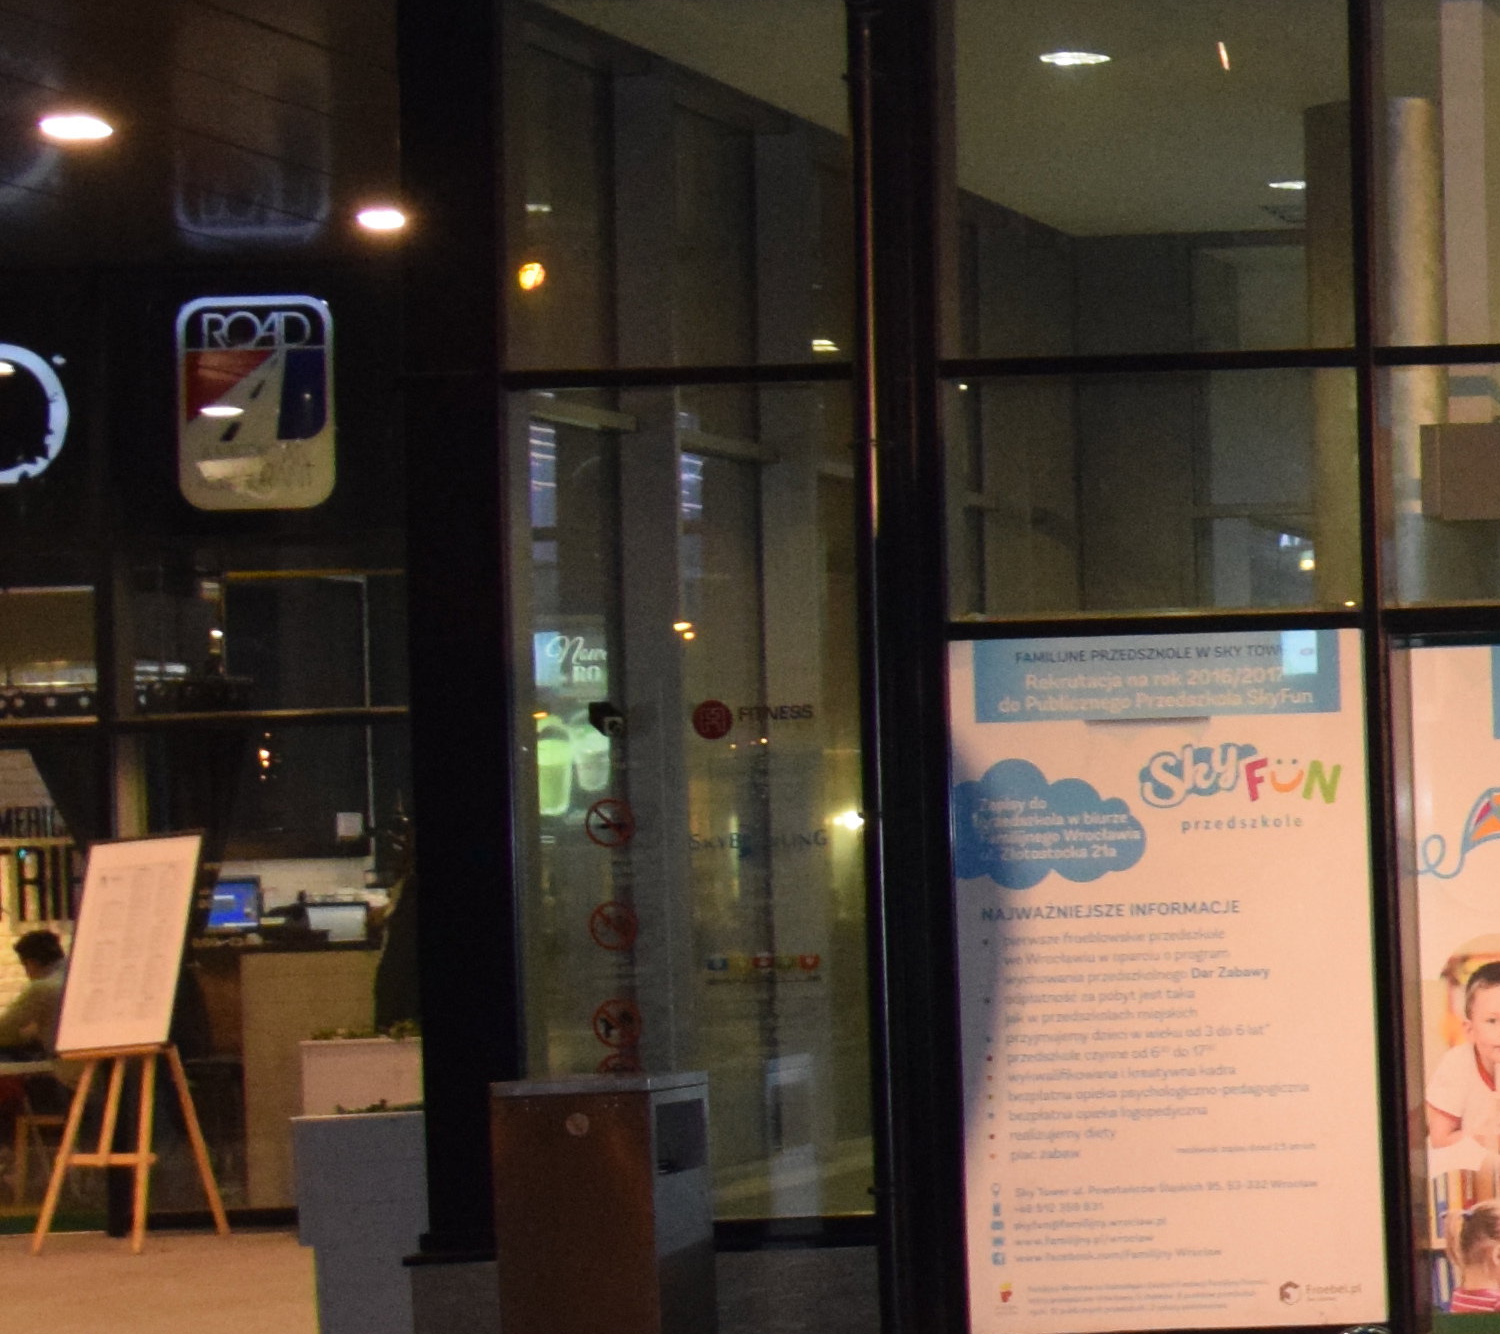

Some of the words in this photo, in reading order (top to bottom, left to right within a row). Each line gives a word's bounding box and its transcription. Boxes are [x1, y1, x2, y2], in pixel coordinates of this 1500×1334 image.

[201, 310, 312, 349] ROAD
[1090, 646, 1192, 662] PRZEDSZKOLE
[1195, 646, 1212, 658] W
[1214, 645, 1241, 657] SKY
[1128, 674, 1150, 688] na
[1153, 670, 1183, 687] rok
[997, 698, 1020, 714] do
[1246, 688, 1314, 706] SkyFun
[1181, 815, 1305, 833] przedszkole
[1129, 899, 1241, 917] INFORMACJE
[1216, 965, 1271, 981] Zabawy
